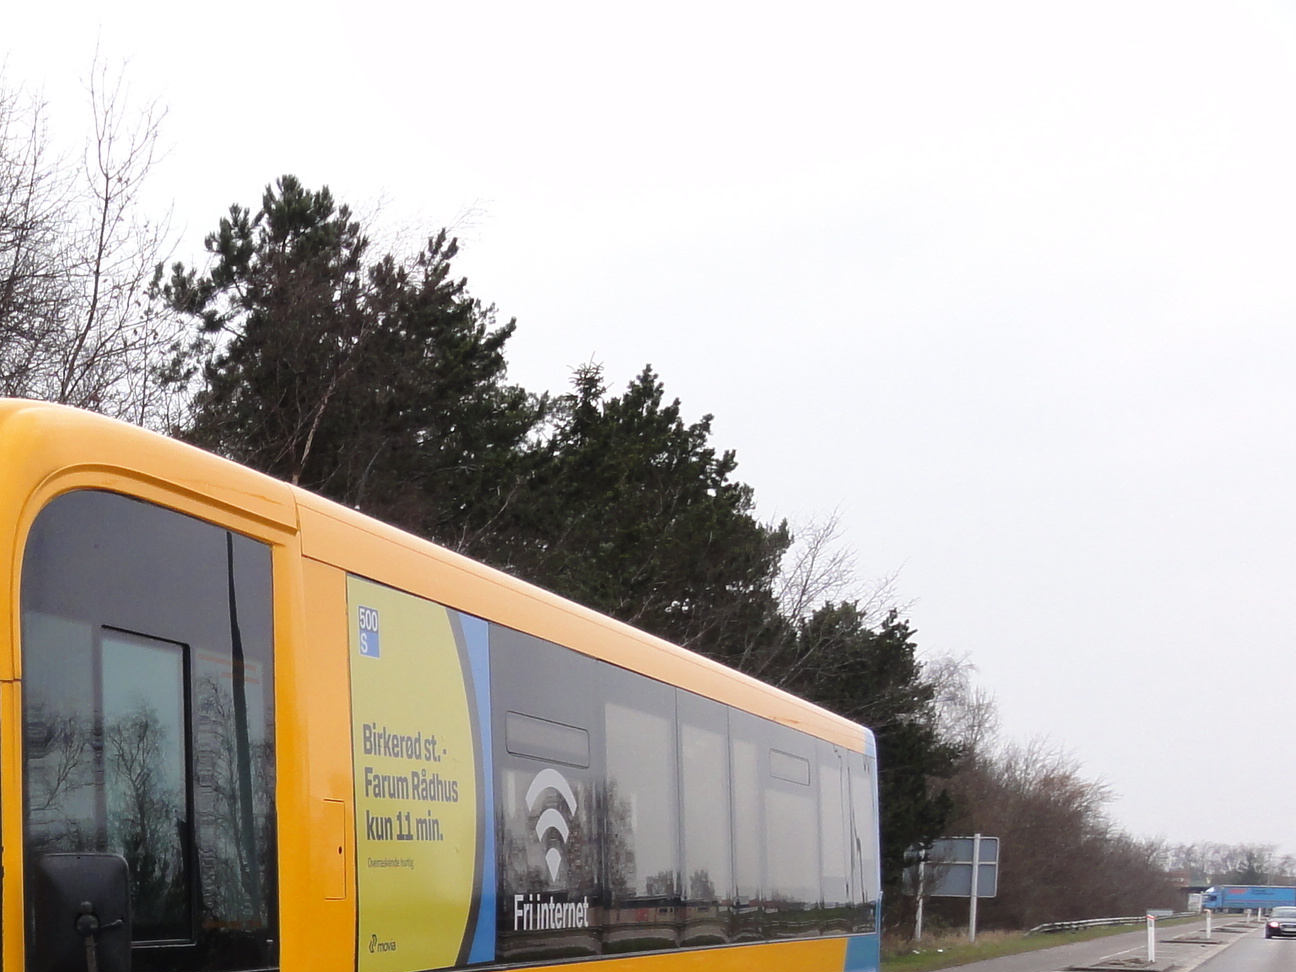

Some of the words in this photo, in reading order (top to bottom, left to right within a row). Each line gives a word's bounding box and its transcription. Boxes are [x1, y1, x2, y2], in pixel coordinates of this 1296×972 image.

[359, 608, 378, 632] 500
[360, 632, 368, 653] S
[362, 722, 422, 759] Birkerød
[364, 767, 409, 799] Farum
[411, 768, 459, 802] Rådhus
[366, 810, 393, 841] kun
[396, 811, 413, 841] 11
[416, 809, 443, 841] min.
[514, 893, 533, 931] Fri
[536, 893, 589, 930] internet
[377, 938, 396, 952] movia
